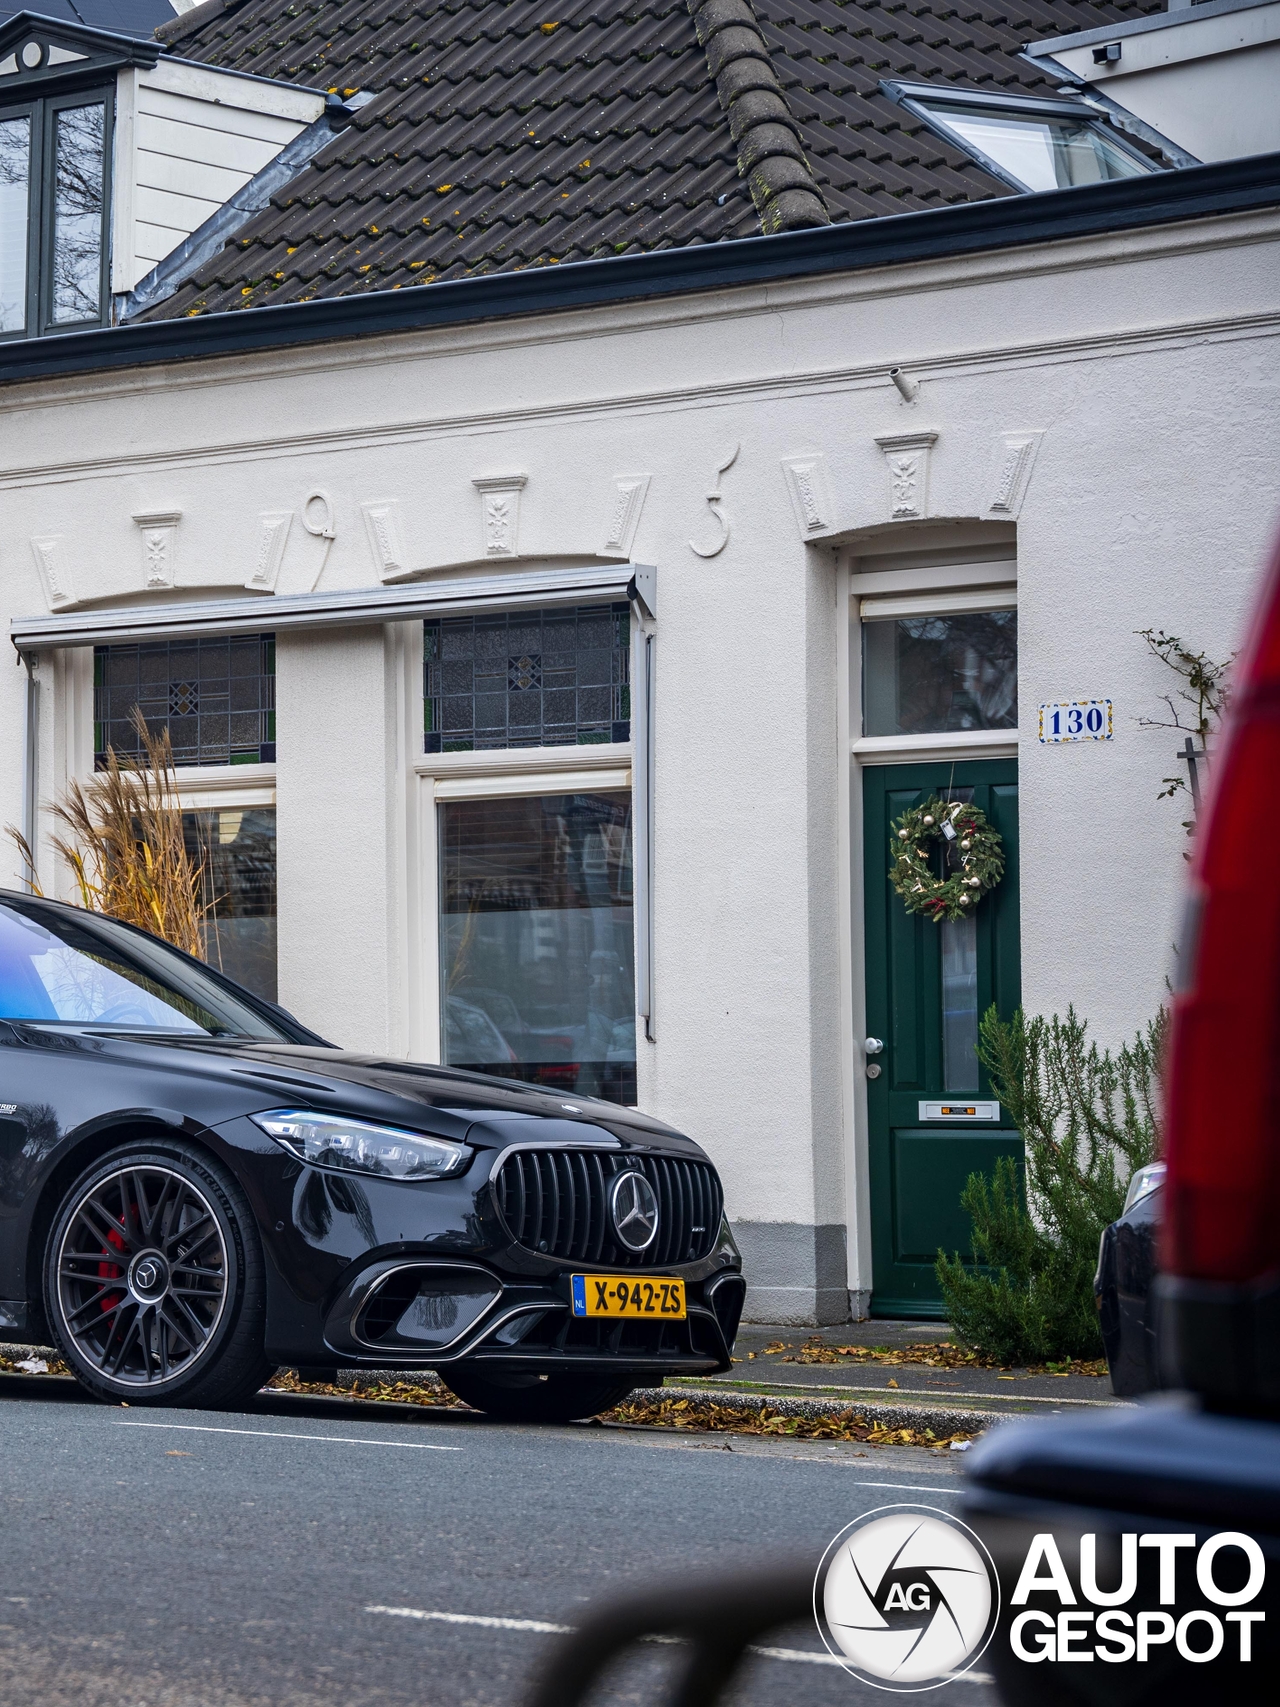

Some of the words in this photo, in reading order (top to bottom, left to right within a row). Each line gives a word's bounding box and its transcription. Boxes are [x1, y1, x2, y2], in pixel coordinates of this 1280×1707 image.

[1050, 708, 1103, 735] 130
[194, 1165, 235, 1219] MICHELIN
[575, 1300, 585, 1309] NL
[595, 1281, 681, 1313] X-942-ZS
